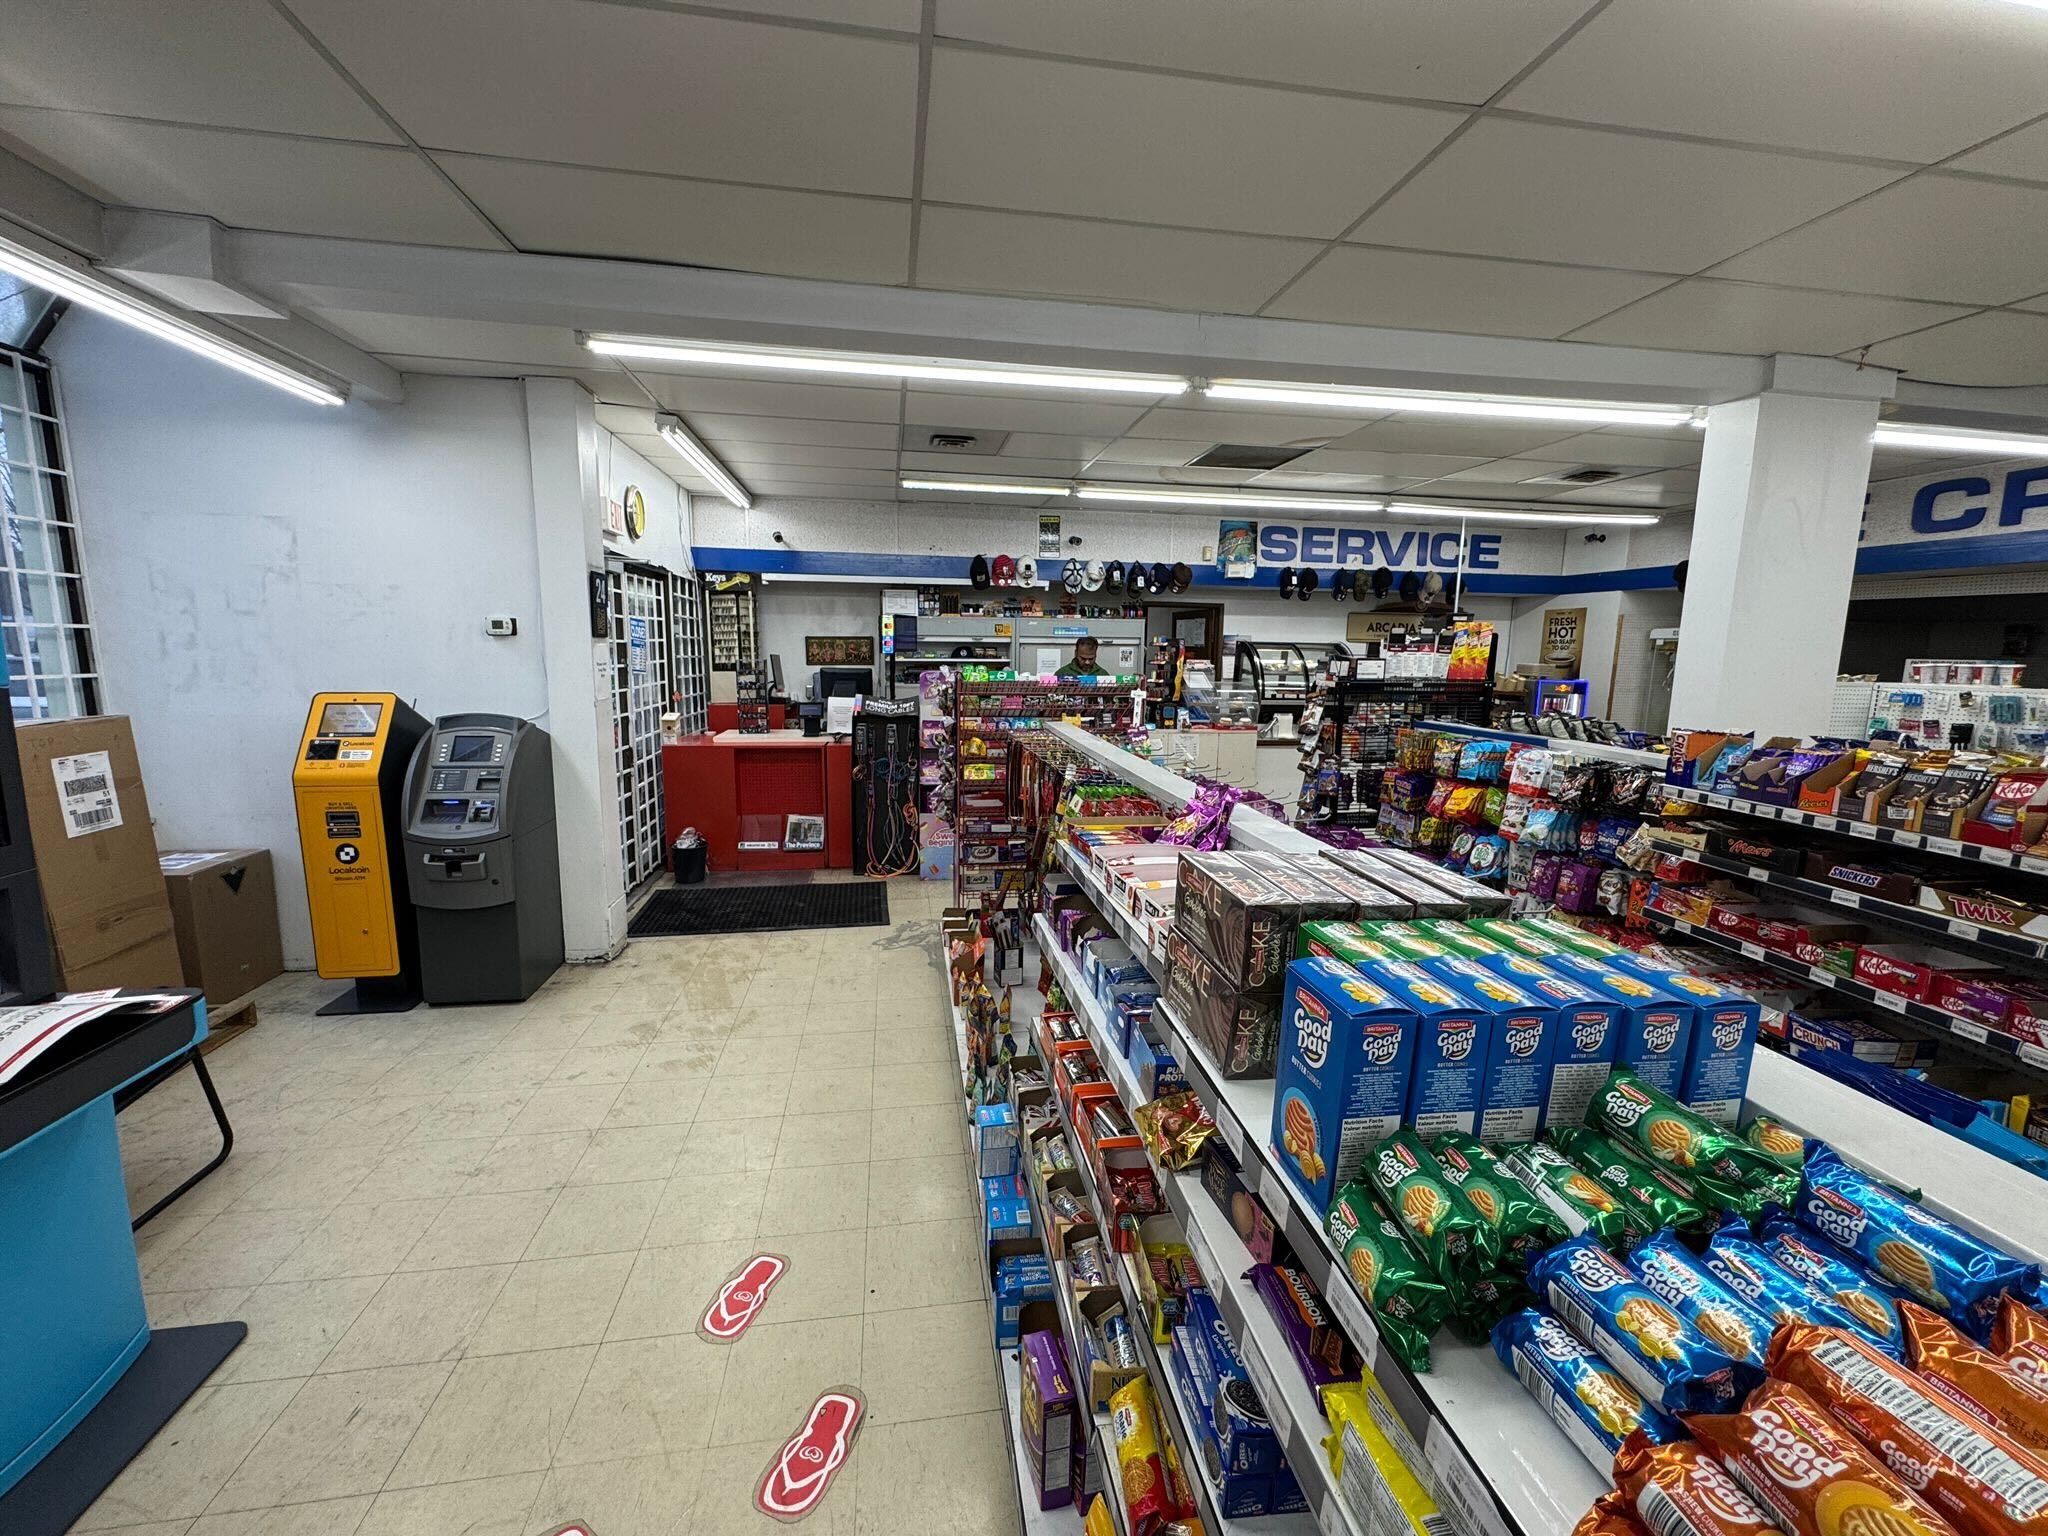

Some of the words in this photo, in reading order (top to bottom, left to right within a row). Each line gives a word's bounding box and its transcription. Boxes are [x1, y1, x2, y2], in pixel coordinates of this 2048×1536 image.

[1260, 526, 1502, 569] SERVICE
[705, 573, 726, 584] Keys
[1366, 622, 1417, 633] ARCADIA
[1549, 626, 1577, 639] HOT
[1550, 617, 1577, 627] FRESH
[865, 700, 898, 709] PREMIUM
[899, 700, 915, 708] 10FT
[865, 706, 886, 714] LONG
[887, 706, 915, 714] CABLES
[1865, 763, 1900, 777] HERSHEY'S
[1902, 773, 1938, 785] HERSHEY'S
[1945, 769, 1983, 781] HERSHEY'S
[1729, 839, 1772, 857] Mars
[329, 866, 370, 874] Localcoin
[1831, 867, 1879, 887] SNICKERS
[1299, 991, 1325, 1017] BRITANNIA
[1294, 1008, 1332, 1042] Good
[1437, 1024, 1476, 1046] Good
[1505, 1021, 1544, 1044] Good
[1572, 1017, 1609, 1038] Good
[1643, 1018, 1680, 1039] Good
[1712, 1016, 1746, 1037] Good
[1793, 1025, 1840, 1050] CRUNCH
[1298, 1030, 1328, 1068] Day
[1362, 1028, 1402, 1050] Good
[1442, 1039, 1472, 1060] Day
[1510, 1035, 1539, 1057] Day
[1576, 1031, 1605, 1052] Day
[1648, 1032, 1676, 1053] Day
[1716, 1031, 1743, 1050] Day
[1367, 1042, 1398, 1064] Day
[1606, 1092, 1653, 1114] Good
[1606, 1102, 1640, 1127] Day
[1377, 1161, 1403, 1187] Day
[1379, 1150, 1417, 1178] Good
[1437, 1155, 1470, 1182] Good
[1817, 1188, 1861, 1215] BRITANNIA
[1330, 1212, 1357, 1241] Good
[1808, 1200, 1868, 1233] Good
[1330, 1227, 1347, 1252] Day
[1816, 1217, 1860, 1248] Day
[1570, 1260, 1617, 1292] Day
[1574, 1249, 1635, 1284] Good
[1641, 1259, 1701, 1298] Good
[1707, 1259, 1766, 1299] Good
[1285, 1268, 1327, 1327] BOURBON
[1560, 1276, 1580, 1295] BUTTER
[1642, 1273, 1685, 1307] Day
[1213, 1318, 1244, 1367] OREO
[1540, 1316, 1598, 1357] Good
[1929, 1377, 1990, 1422] BRITANNIA
[1780, 1402, 1833, 1452] BRITANNIA
[1834, 1406, 1867, 1435] BRITANNIA
[1750, 1408, 1849, 1477] Good
[1749, 1429, 1822, 1488] Day
[1879, 1438, 1939, 1479] Good
[1887, 1454, 1929, 1490] Day
[1689, 1466, 1762, 1524] Day
[1695, 1454, 1776, 1526] Good
[1740, 1453, 1772, 1488] CASHEW
[1771, 1485, 1800, 1517] COOKIES
